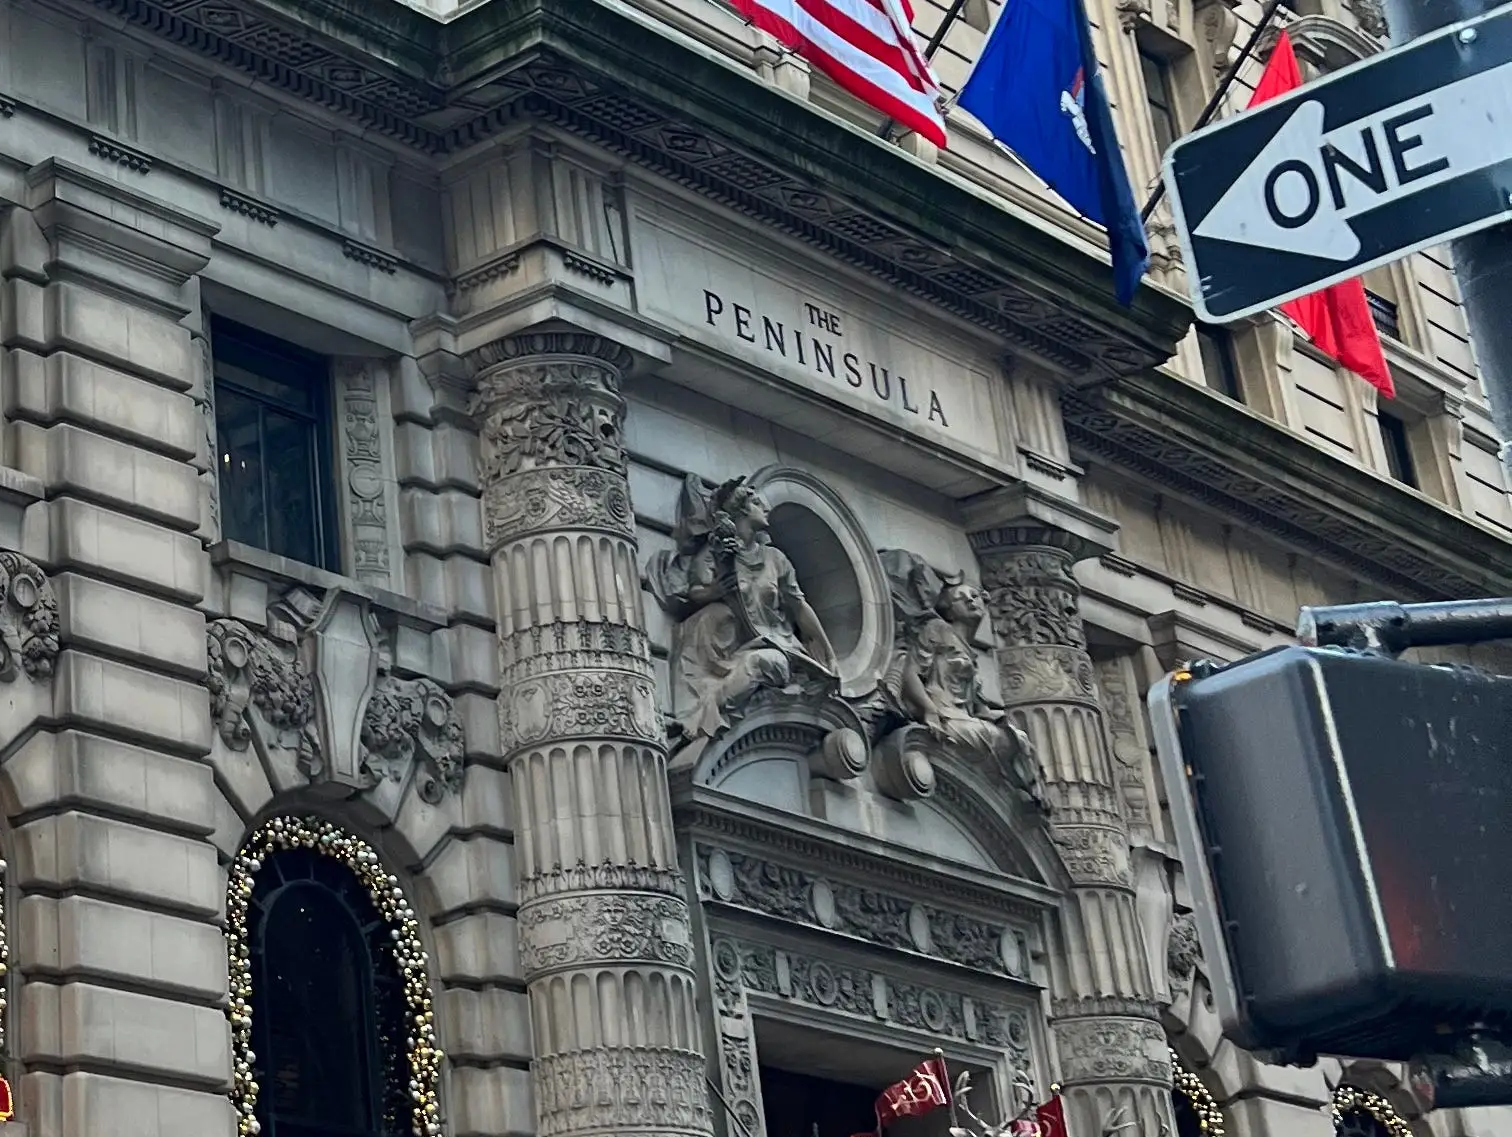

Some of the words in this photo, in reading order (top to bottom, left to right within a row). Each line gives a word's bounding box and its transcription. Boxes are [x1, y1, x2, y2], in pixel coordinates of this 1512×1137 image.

[1264, 103, 1450, 229] ONE
[702, 288, 950, 428] PENINSULA
[804, 302, 842, 337] THE
